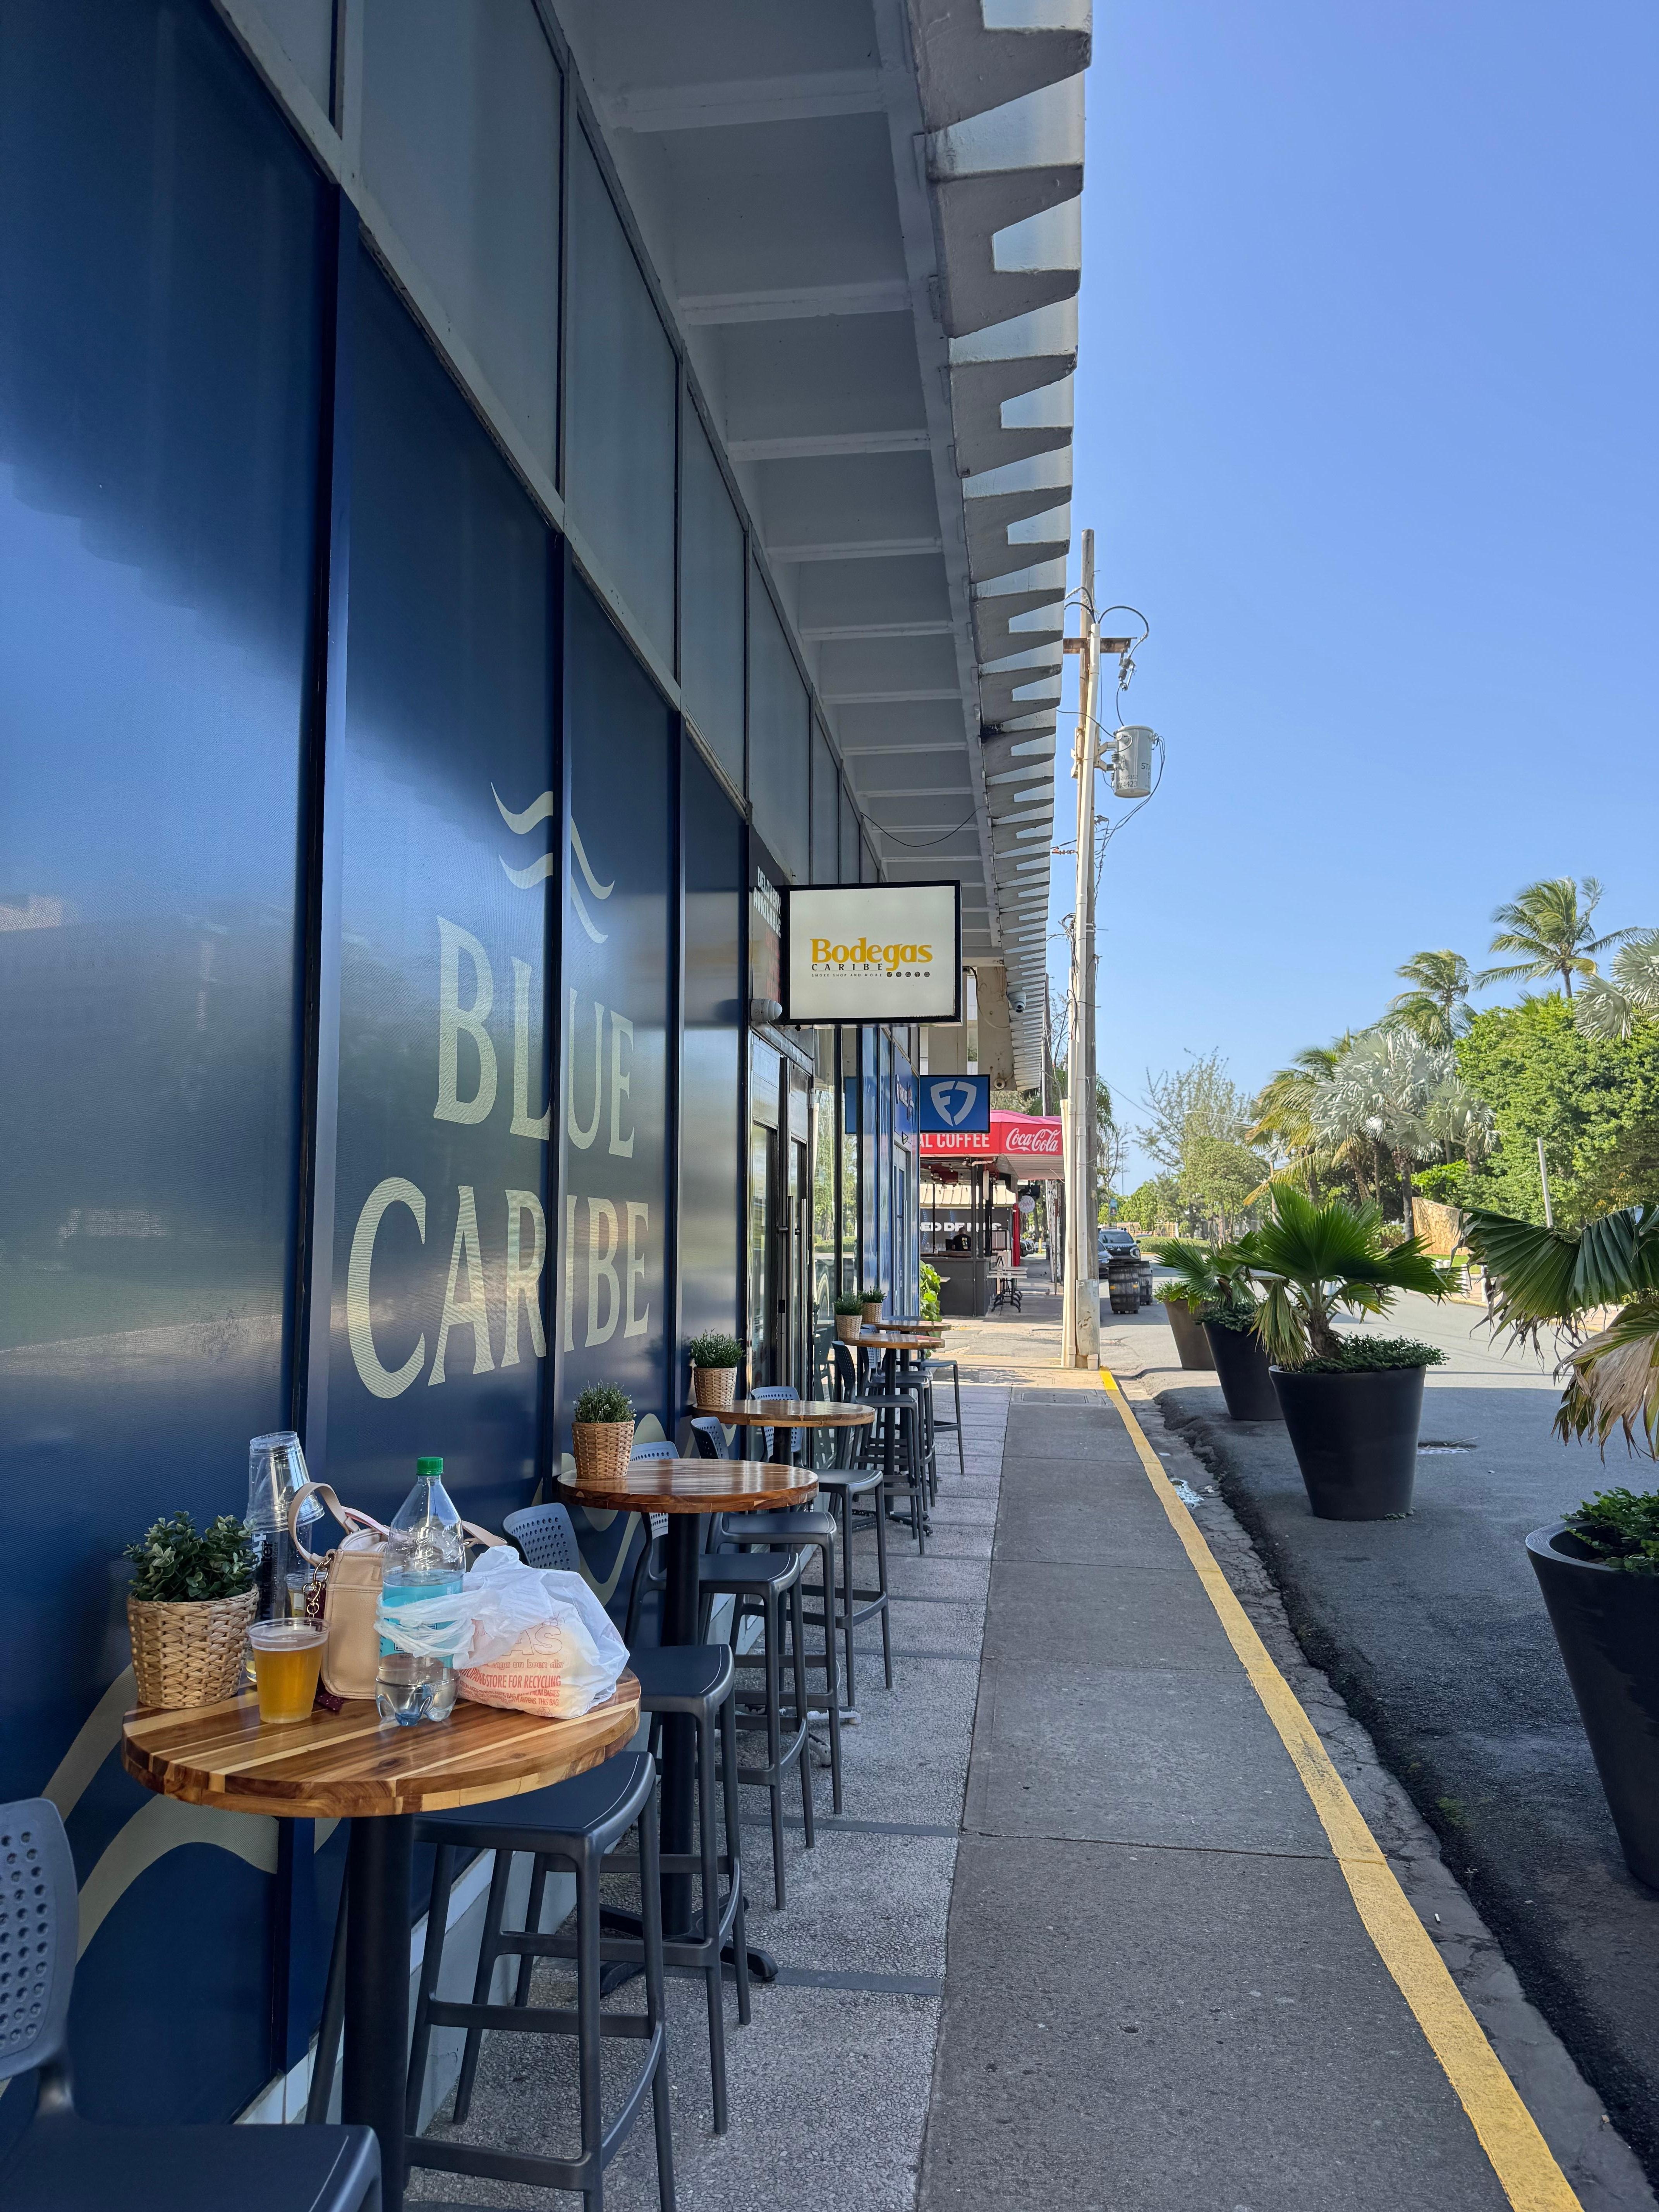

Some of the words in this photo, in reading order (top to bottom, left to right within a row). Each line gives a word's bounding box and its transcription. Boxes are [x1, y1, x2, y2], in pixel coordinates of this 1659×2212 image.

[754, 886, 781, 938] AVAILABLE
[810, 937, 933, 972] Bodegas
[434, 915, 635, 1158] BLUE
[937, 1134, 990, 1148] COFFEE
[1006, 1127, 1061, 1152] Coca-Cola
[347, 1177, 649, 1399] CARIBE
[486, 1674, 507, 1688] STORE
[508, 1675, 522, 1688] FOR
[524, 1675, 561, 1688] RECYCLING
